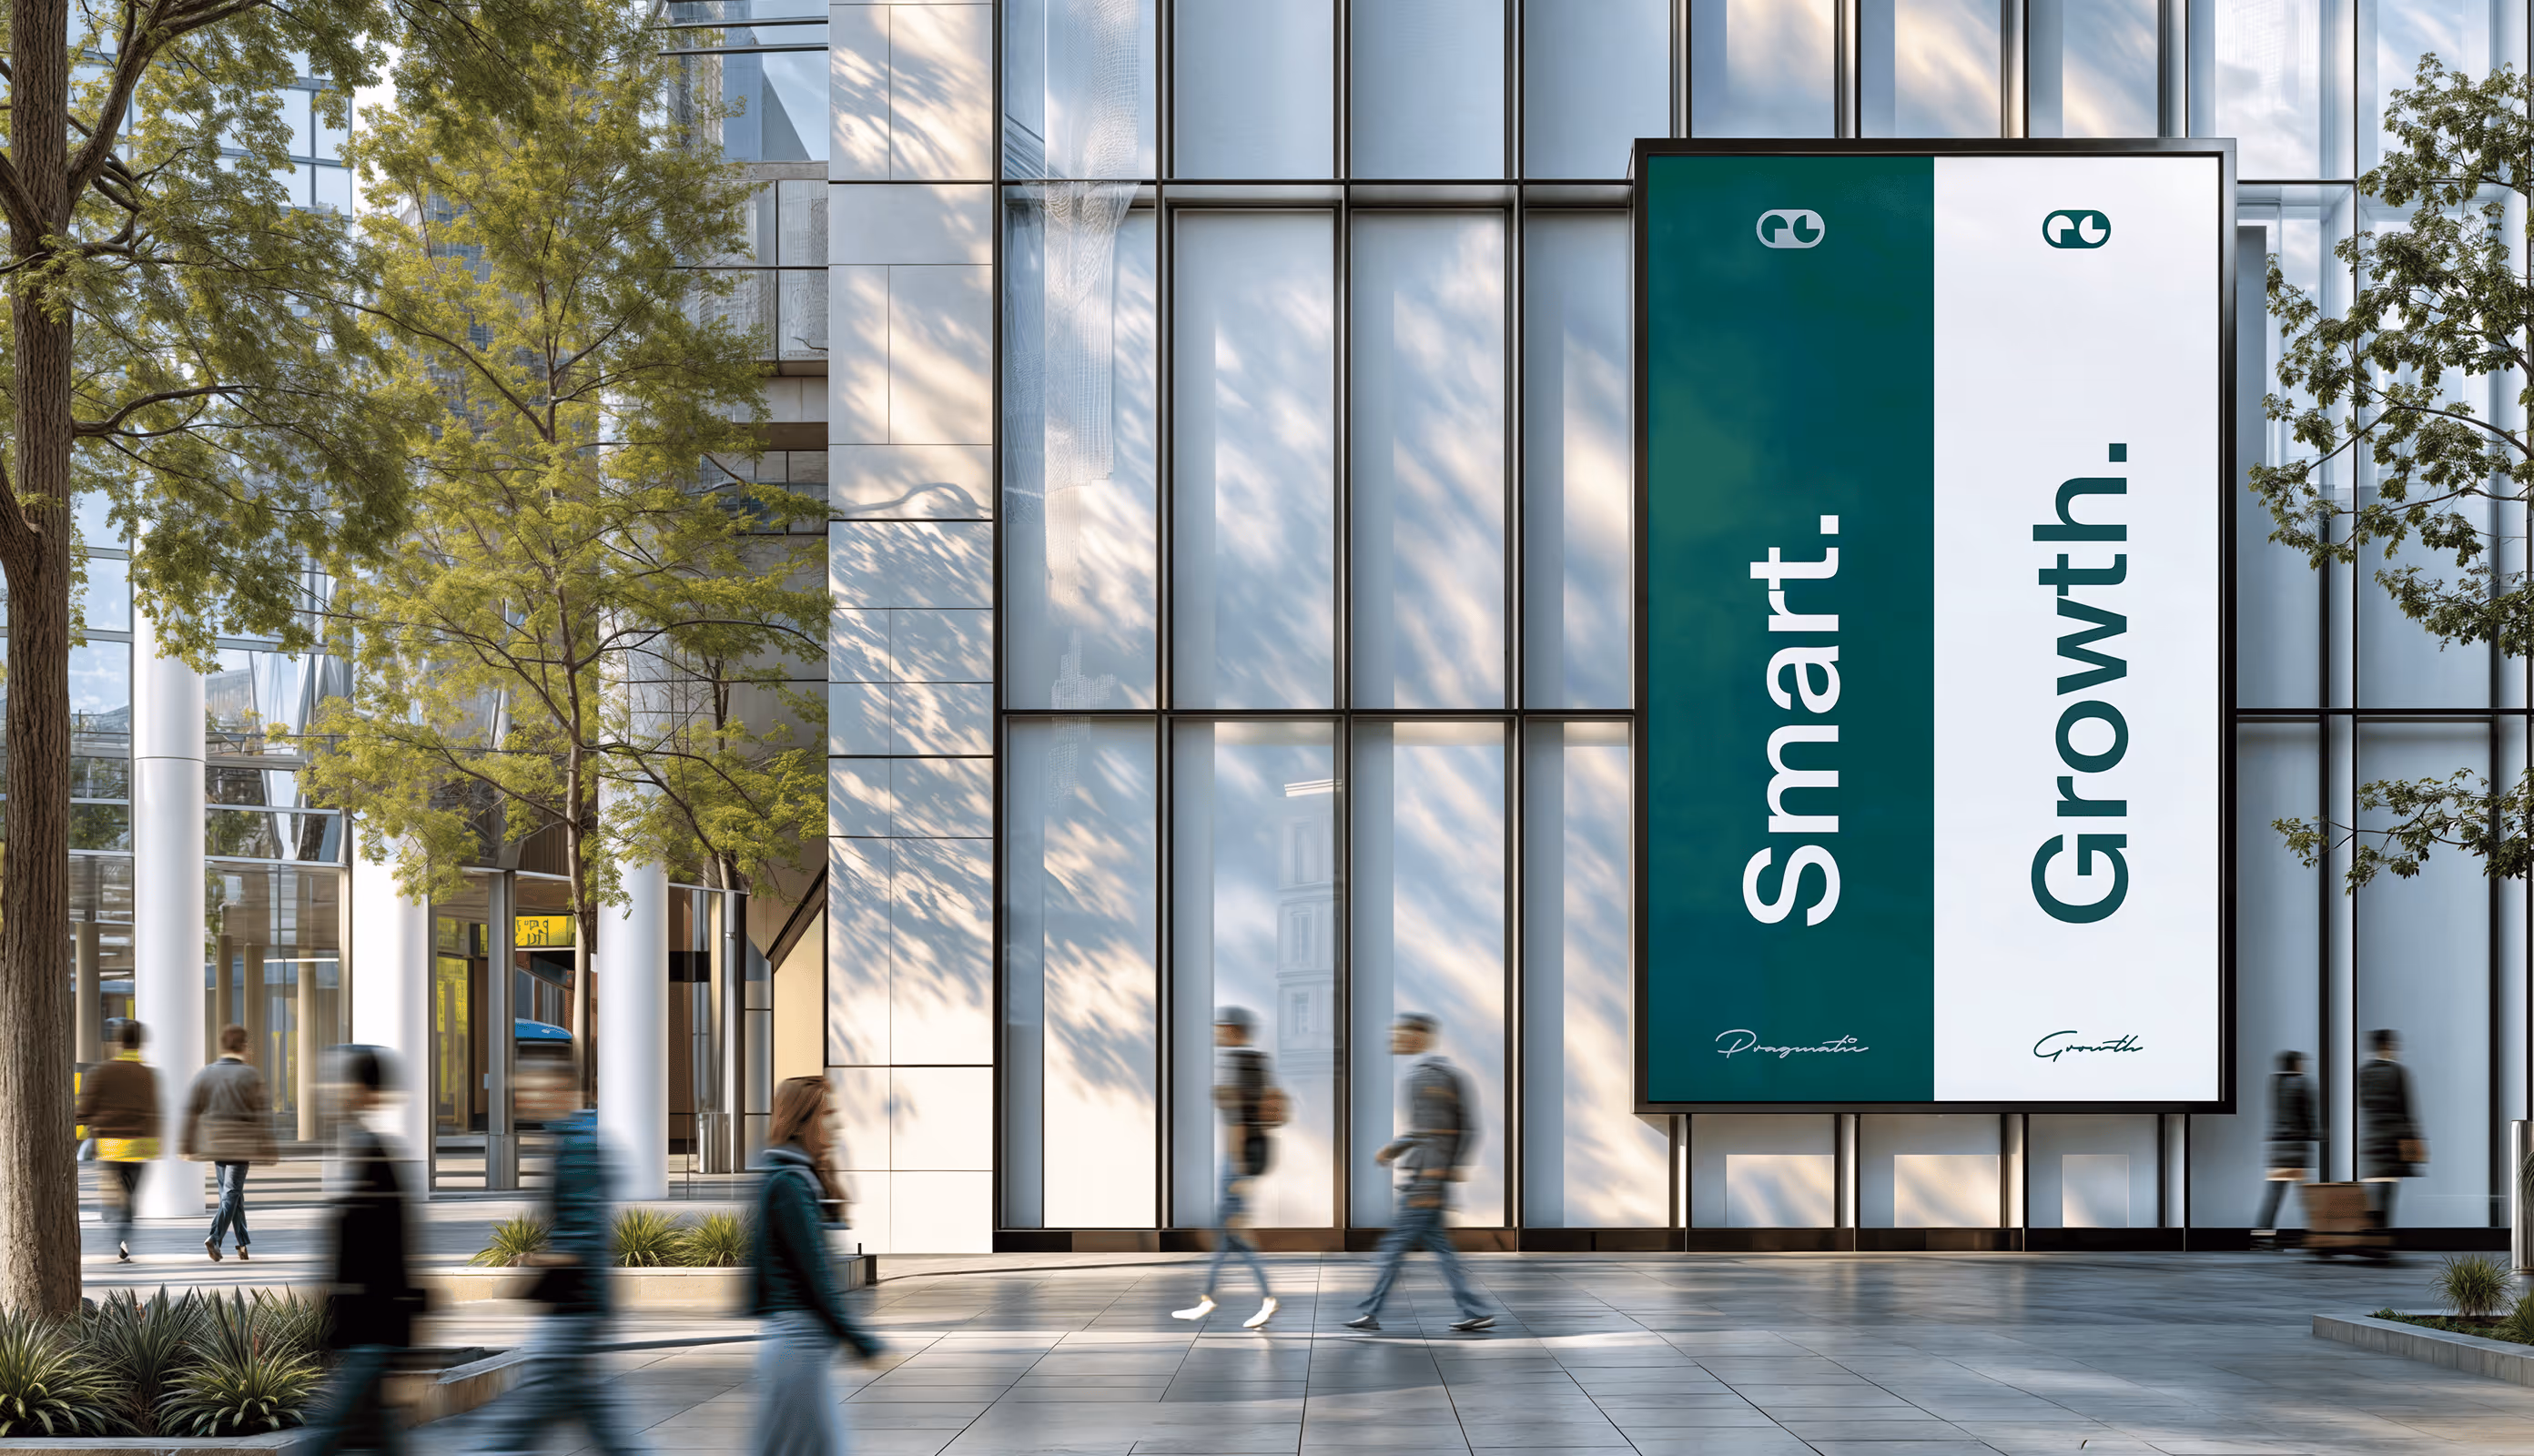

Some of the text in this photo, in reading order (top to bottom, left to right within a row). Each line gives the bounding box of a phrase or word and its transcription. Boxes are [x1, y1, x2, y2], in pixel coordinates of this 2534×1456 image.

[1743, 515, 1840, 925] Smart.
[2032, 443, 2128, 924] Growth.
[1716, 1029, 1869, 1058] Pragmatic
[2033, 1031, 2143, 1062] Growth
